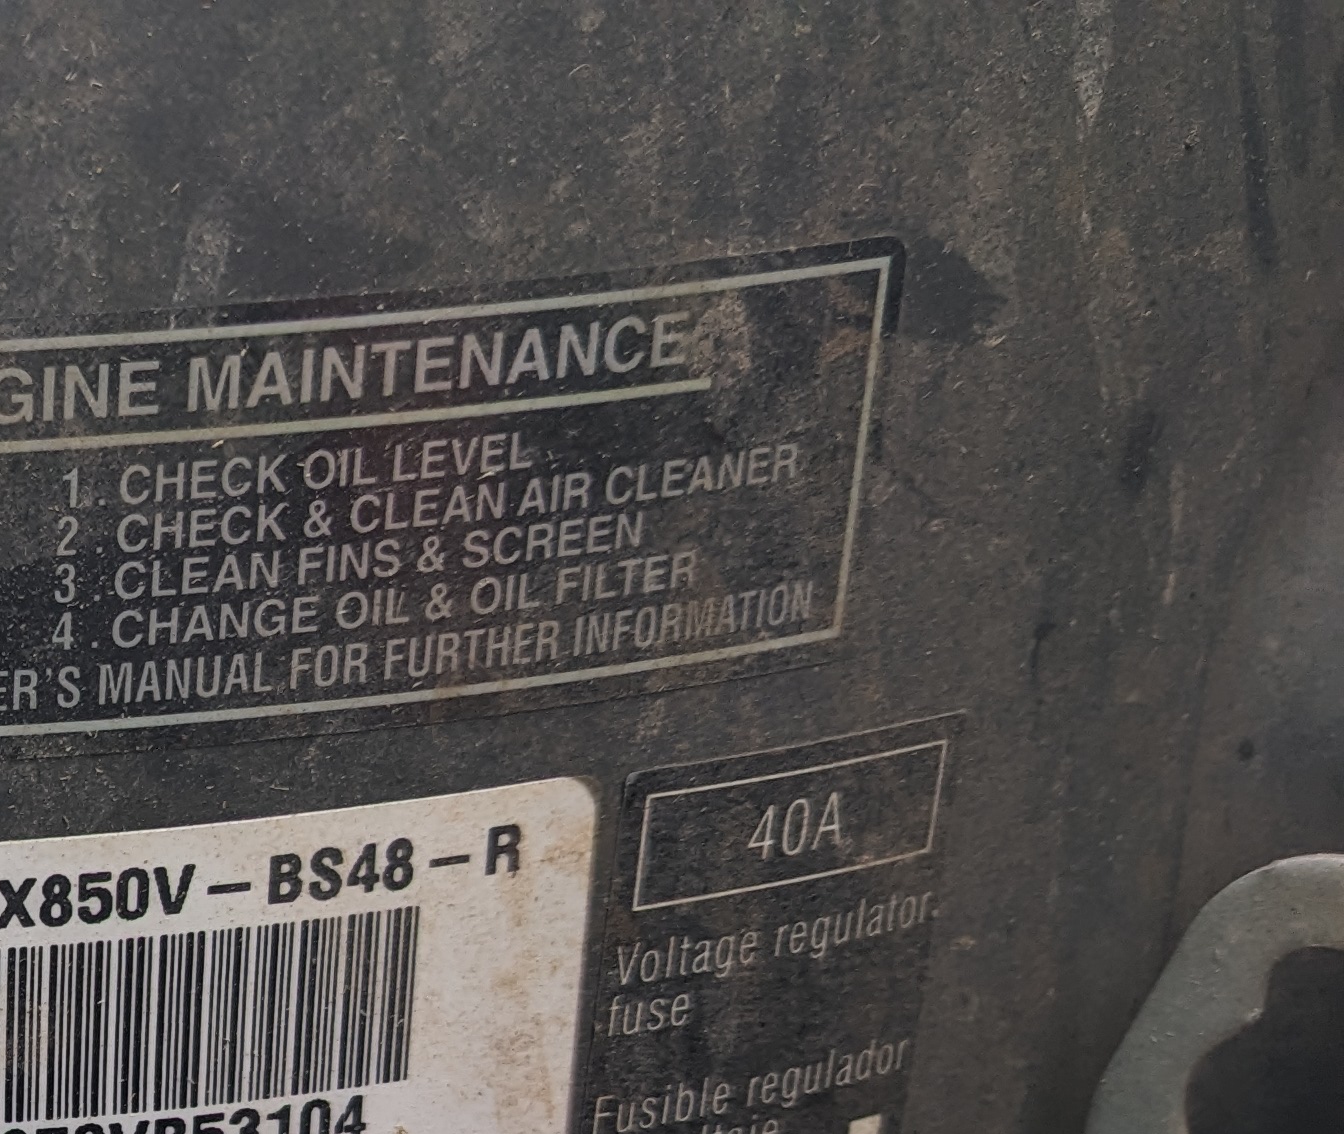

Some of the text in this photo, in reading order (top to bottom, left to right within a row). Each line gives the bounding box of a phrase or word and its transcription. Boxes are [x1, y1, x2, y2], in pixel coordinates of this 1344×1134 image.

[186, 311, 690, 413] MAINTENANCE
[116, 503, 286, 553] CHECK
[303, 500, 333, 537] &
[350, 482, 504, 533] CLEAN
[517, 473, 589, 515] AIR
[605, 444, 798, 504] CLEANER
[119, 455, 285, 505] CHECK
[303, 448, 377, 490] OIL
[392, 434, 533, 482] LEVEL
[114, 552, 279, 598] CLEAN
[297, 541, 400, 583] FINS
[416, 538, 445, 572] &
[462, 512, 644, 565] SCREEN
[111, 597, 319, 648] CHANGE
[335, 590, 409, 630] OIL
[425, 584, 453, 620] &
[470, 574, 541, 616] OIL
[555, 552, 697, 605] FILTER
[97, 652, 271, 704] MANUAL
[289, 642, 367, 690] FOR
[384, 621, 559, 680] FURTHER
[572, 580, 813, 656] INFORMATION
[747, 792, 844, 860] 40A
[617, 929, 758, 985] Voltage
[608, 994, 690, 1037] fuse
[746, 1036, 910, 1110] regulador
